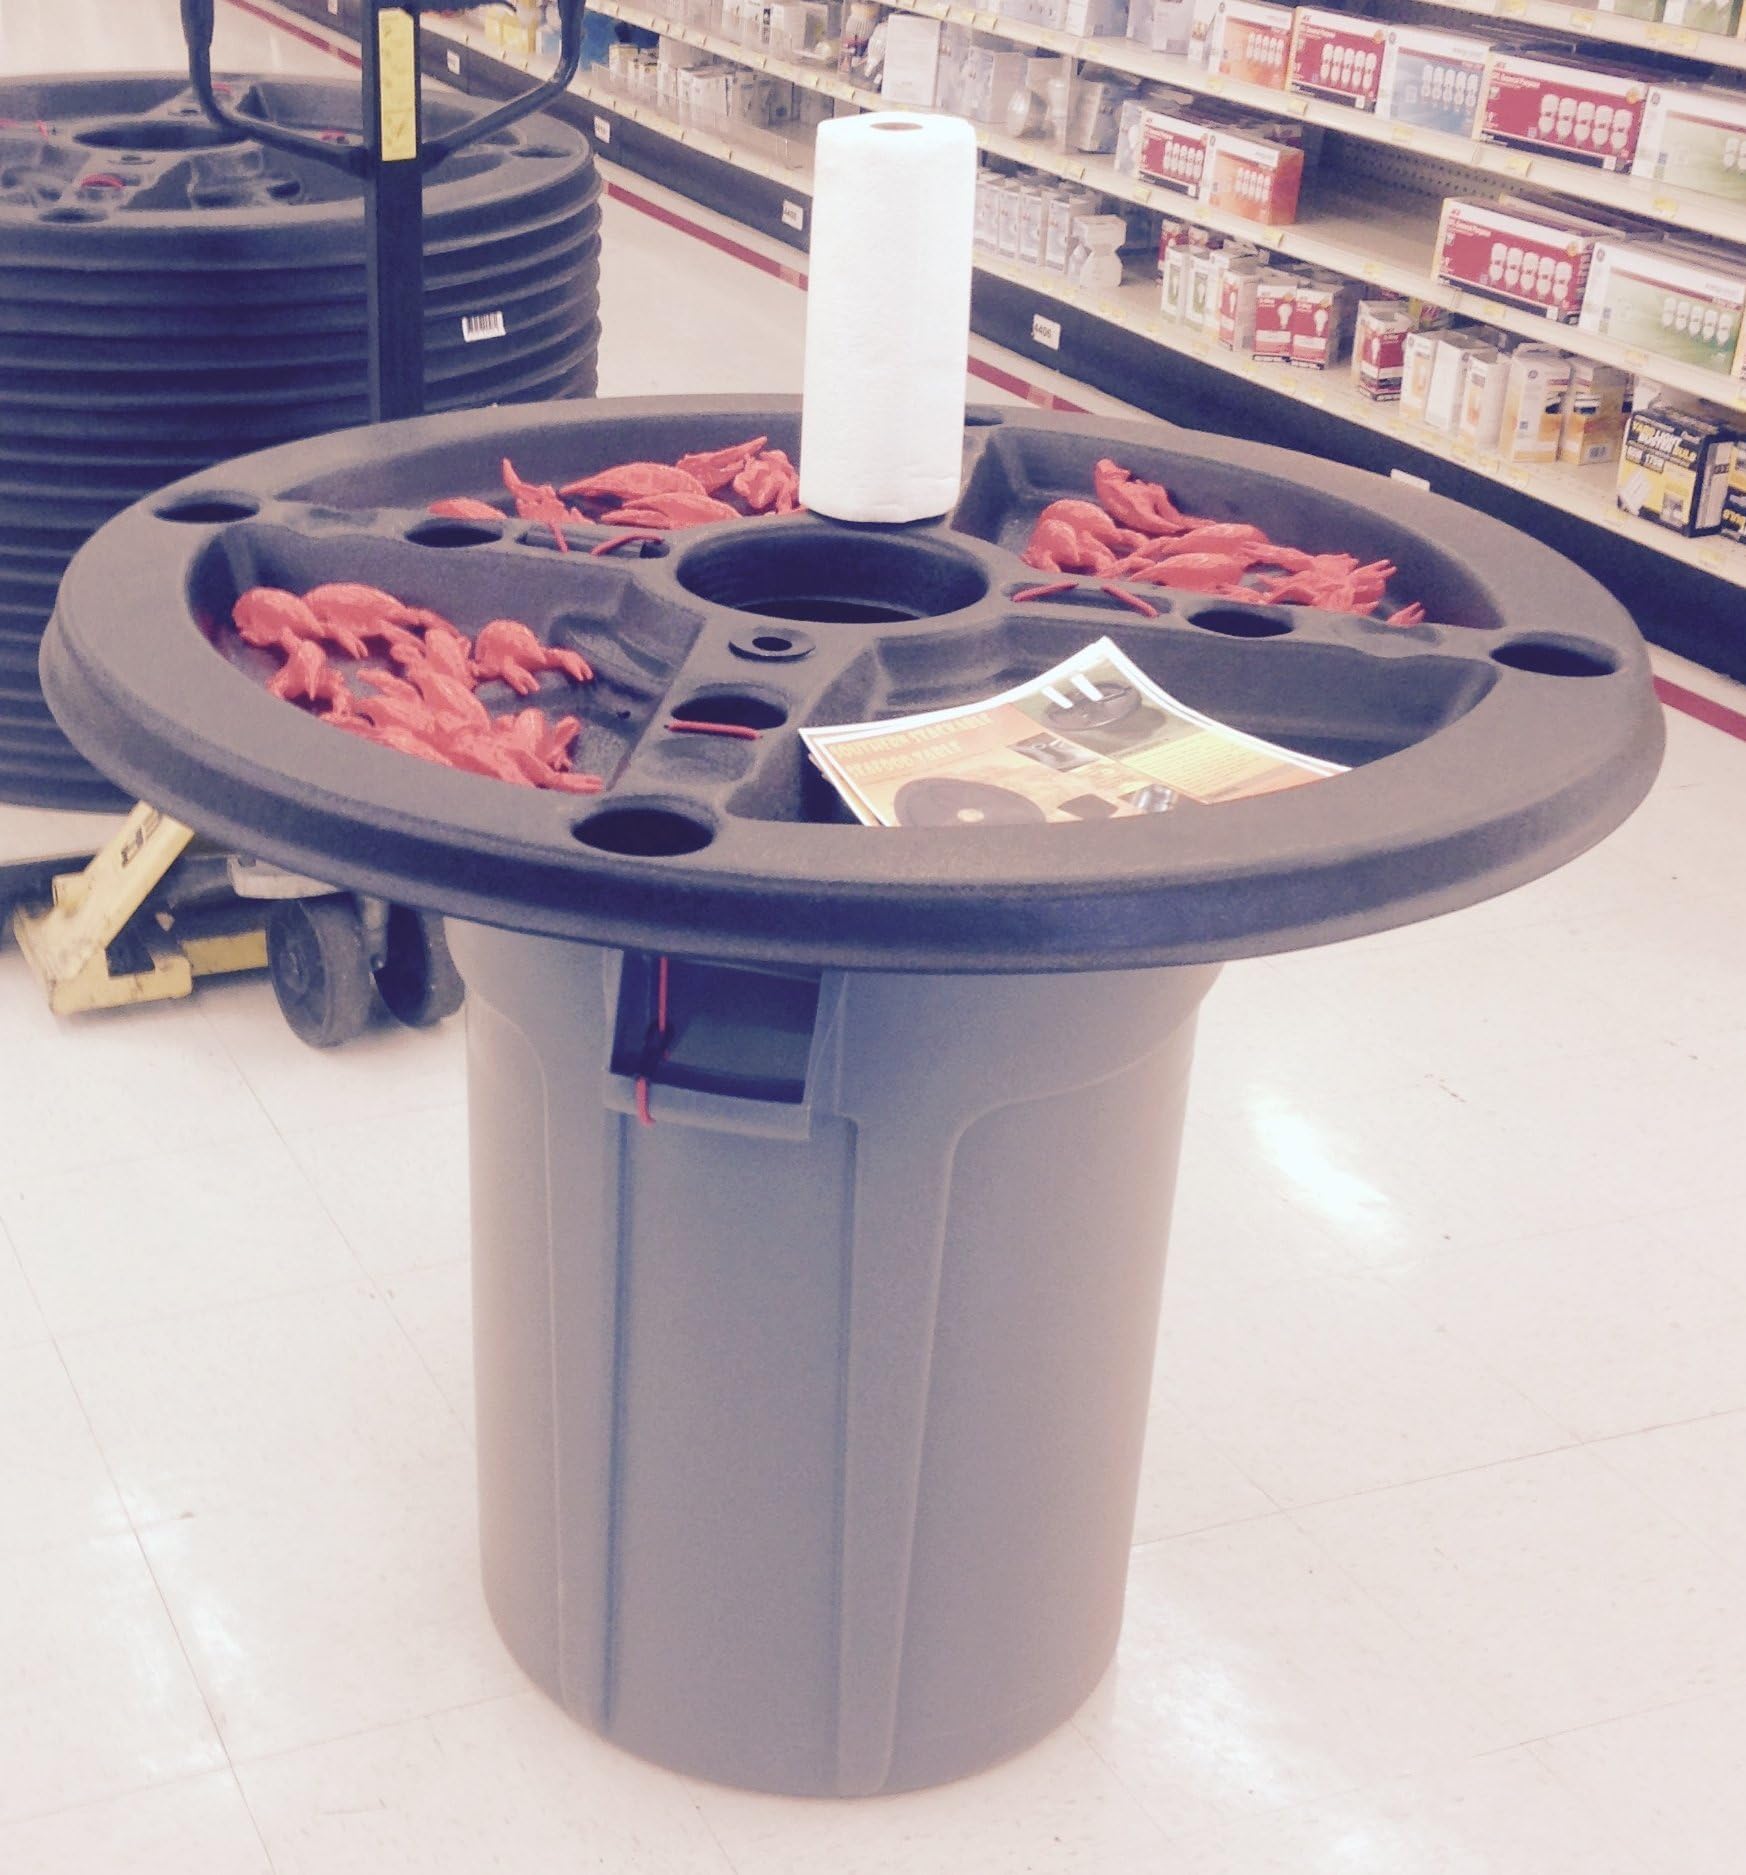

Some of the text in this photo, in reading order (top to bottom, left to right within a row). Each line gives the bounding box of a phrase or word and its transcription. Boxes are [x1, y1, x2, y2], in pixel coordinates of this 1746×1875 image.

[1034, 322, 1052, 339] 4406
[911, 712, 993, 744] STACKABLE
[917, 740, 962, 767] TABLE
